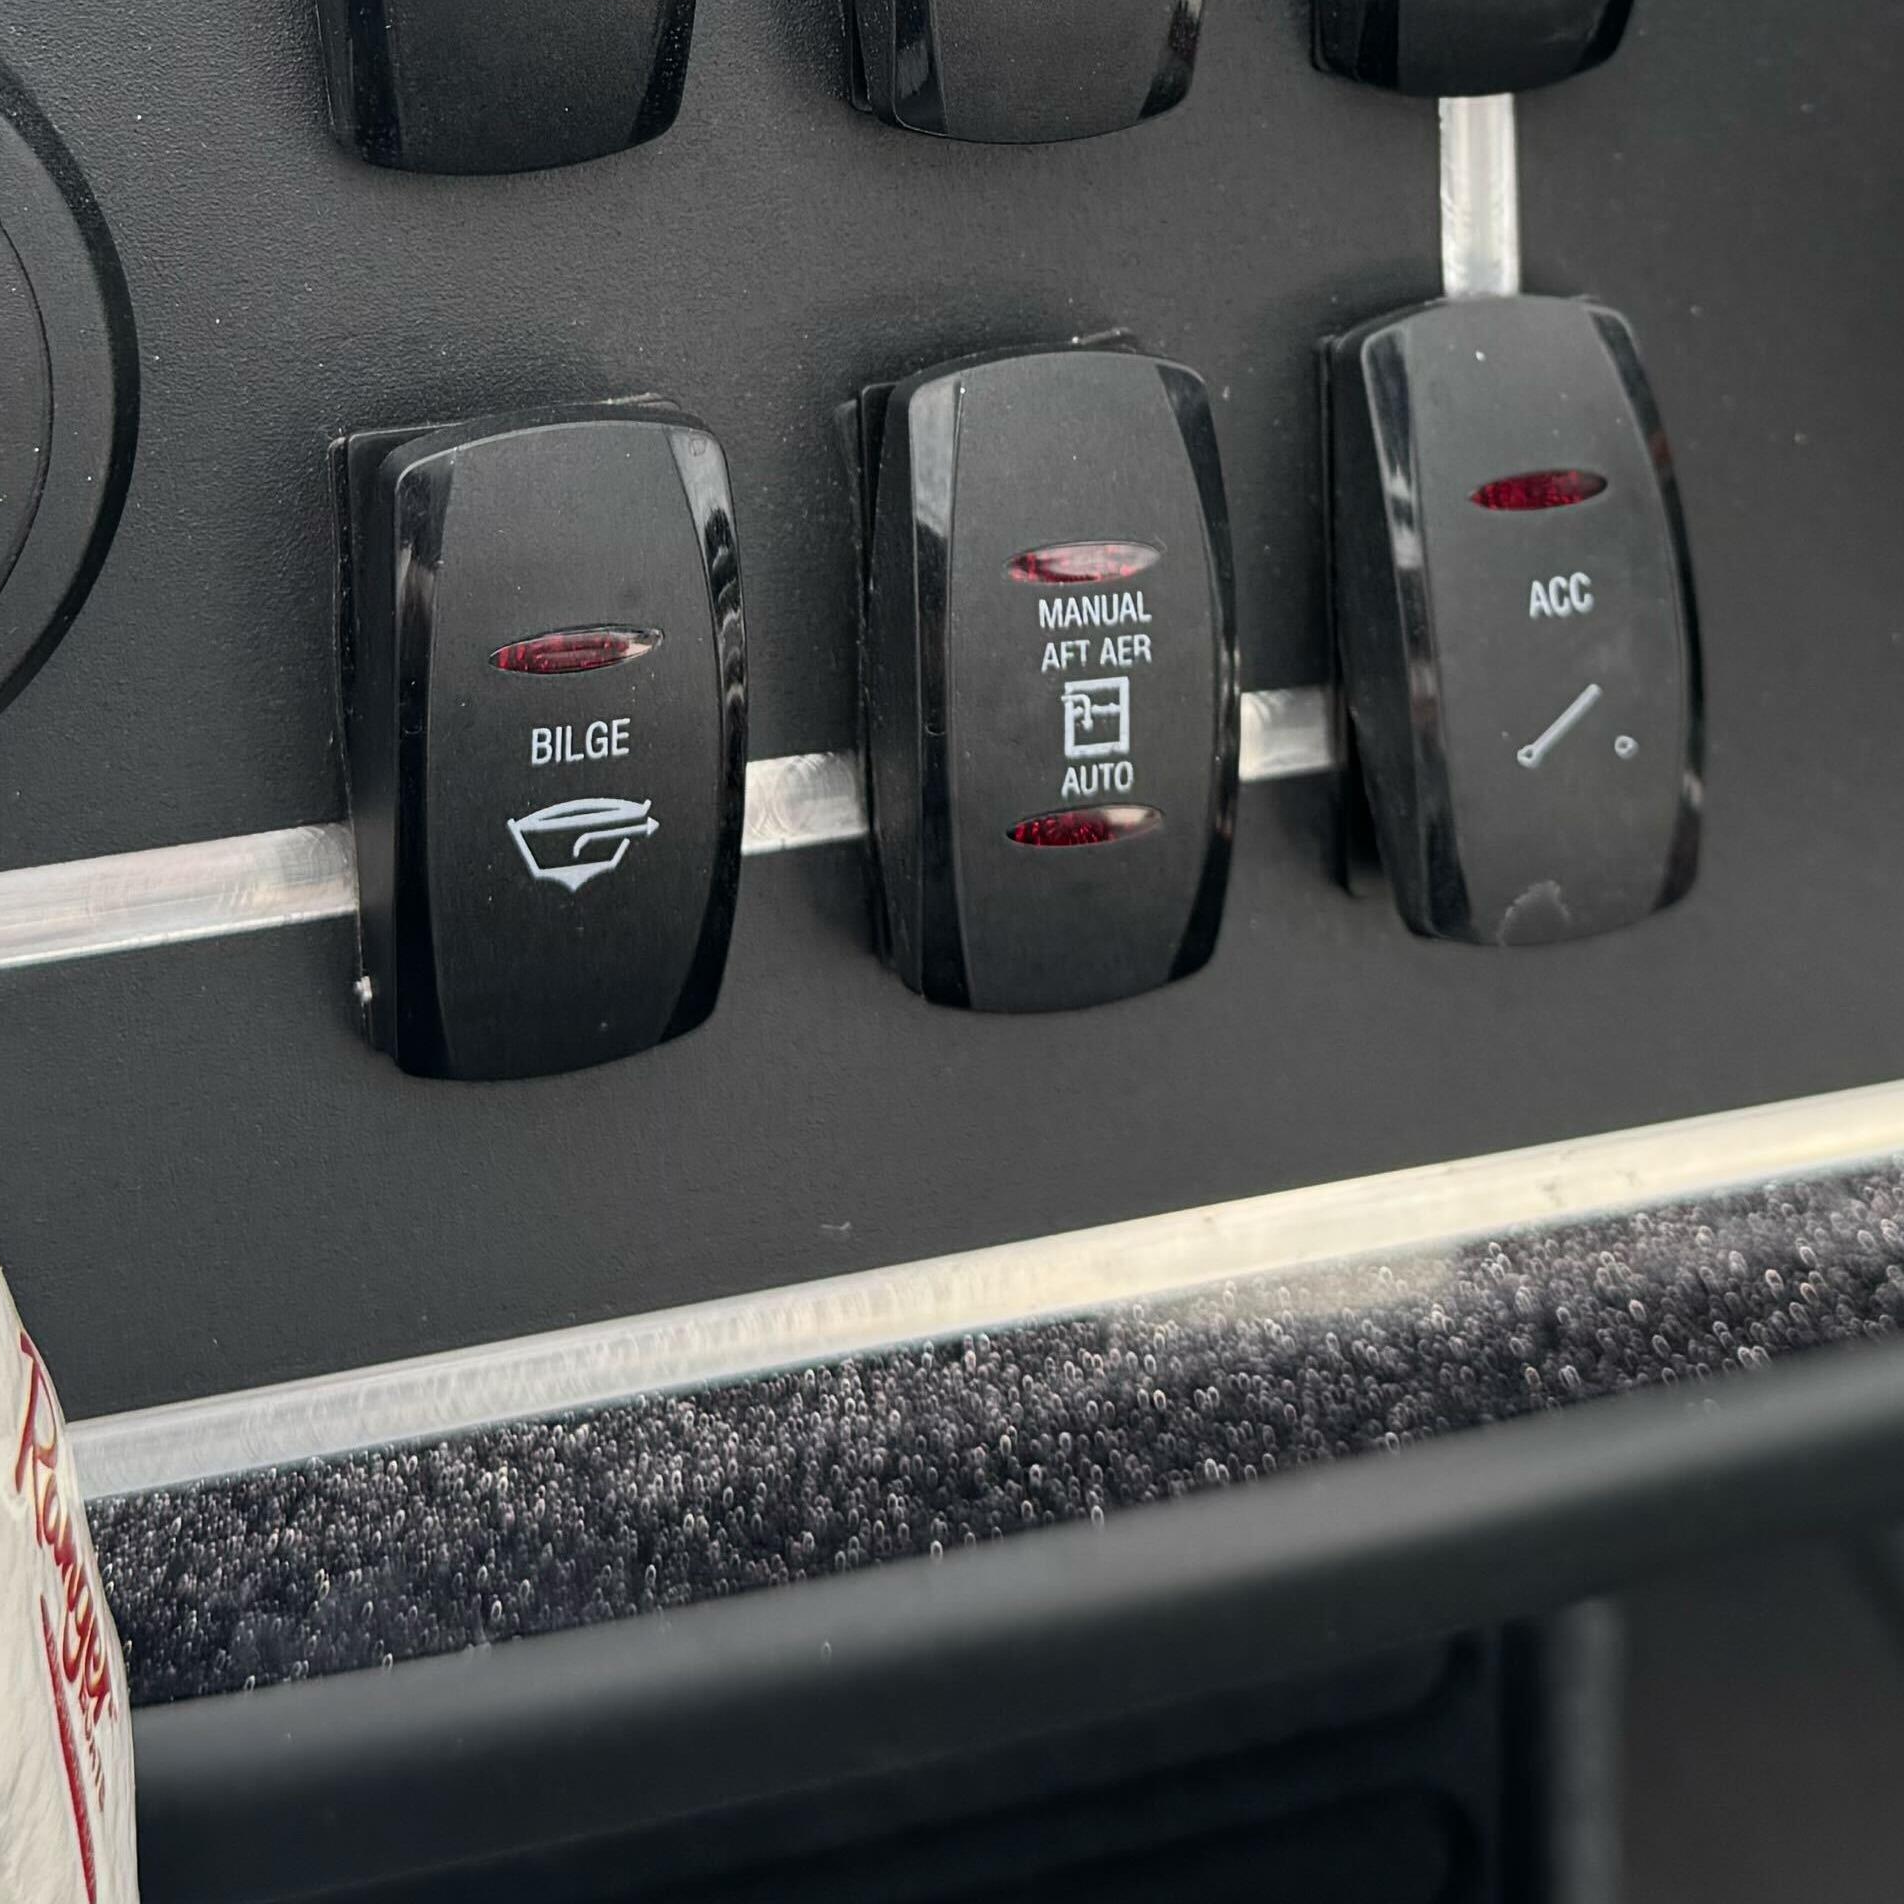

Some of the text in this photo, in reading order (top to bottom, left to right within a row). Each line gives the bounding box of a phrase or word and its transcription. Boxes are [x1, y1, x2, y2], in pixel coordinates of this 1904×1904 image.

[1038, 590, 1152, 630] MANUAL
[1529, 571, 1595, 619] ACC
[1041, 633, 1153, 673] AFT AER
[530, 717, 631, 767] BILGE
[1061, 760, 1134, 797] AUTO
[14, 1329, 111, 1728] Ranger
